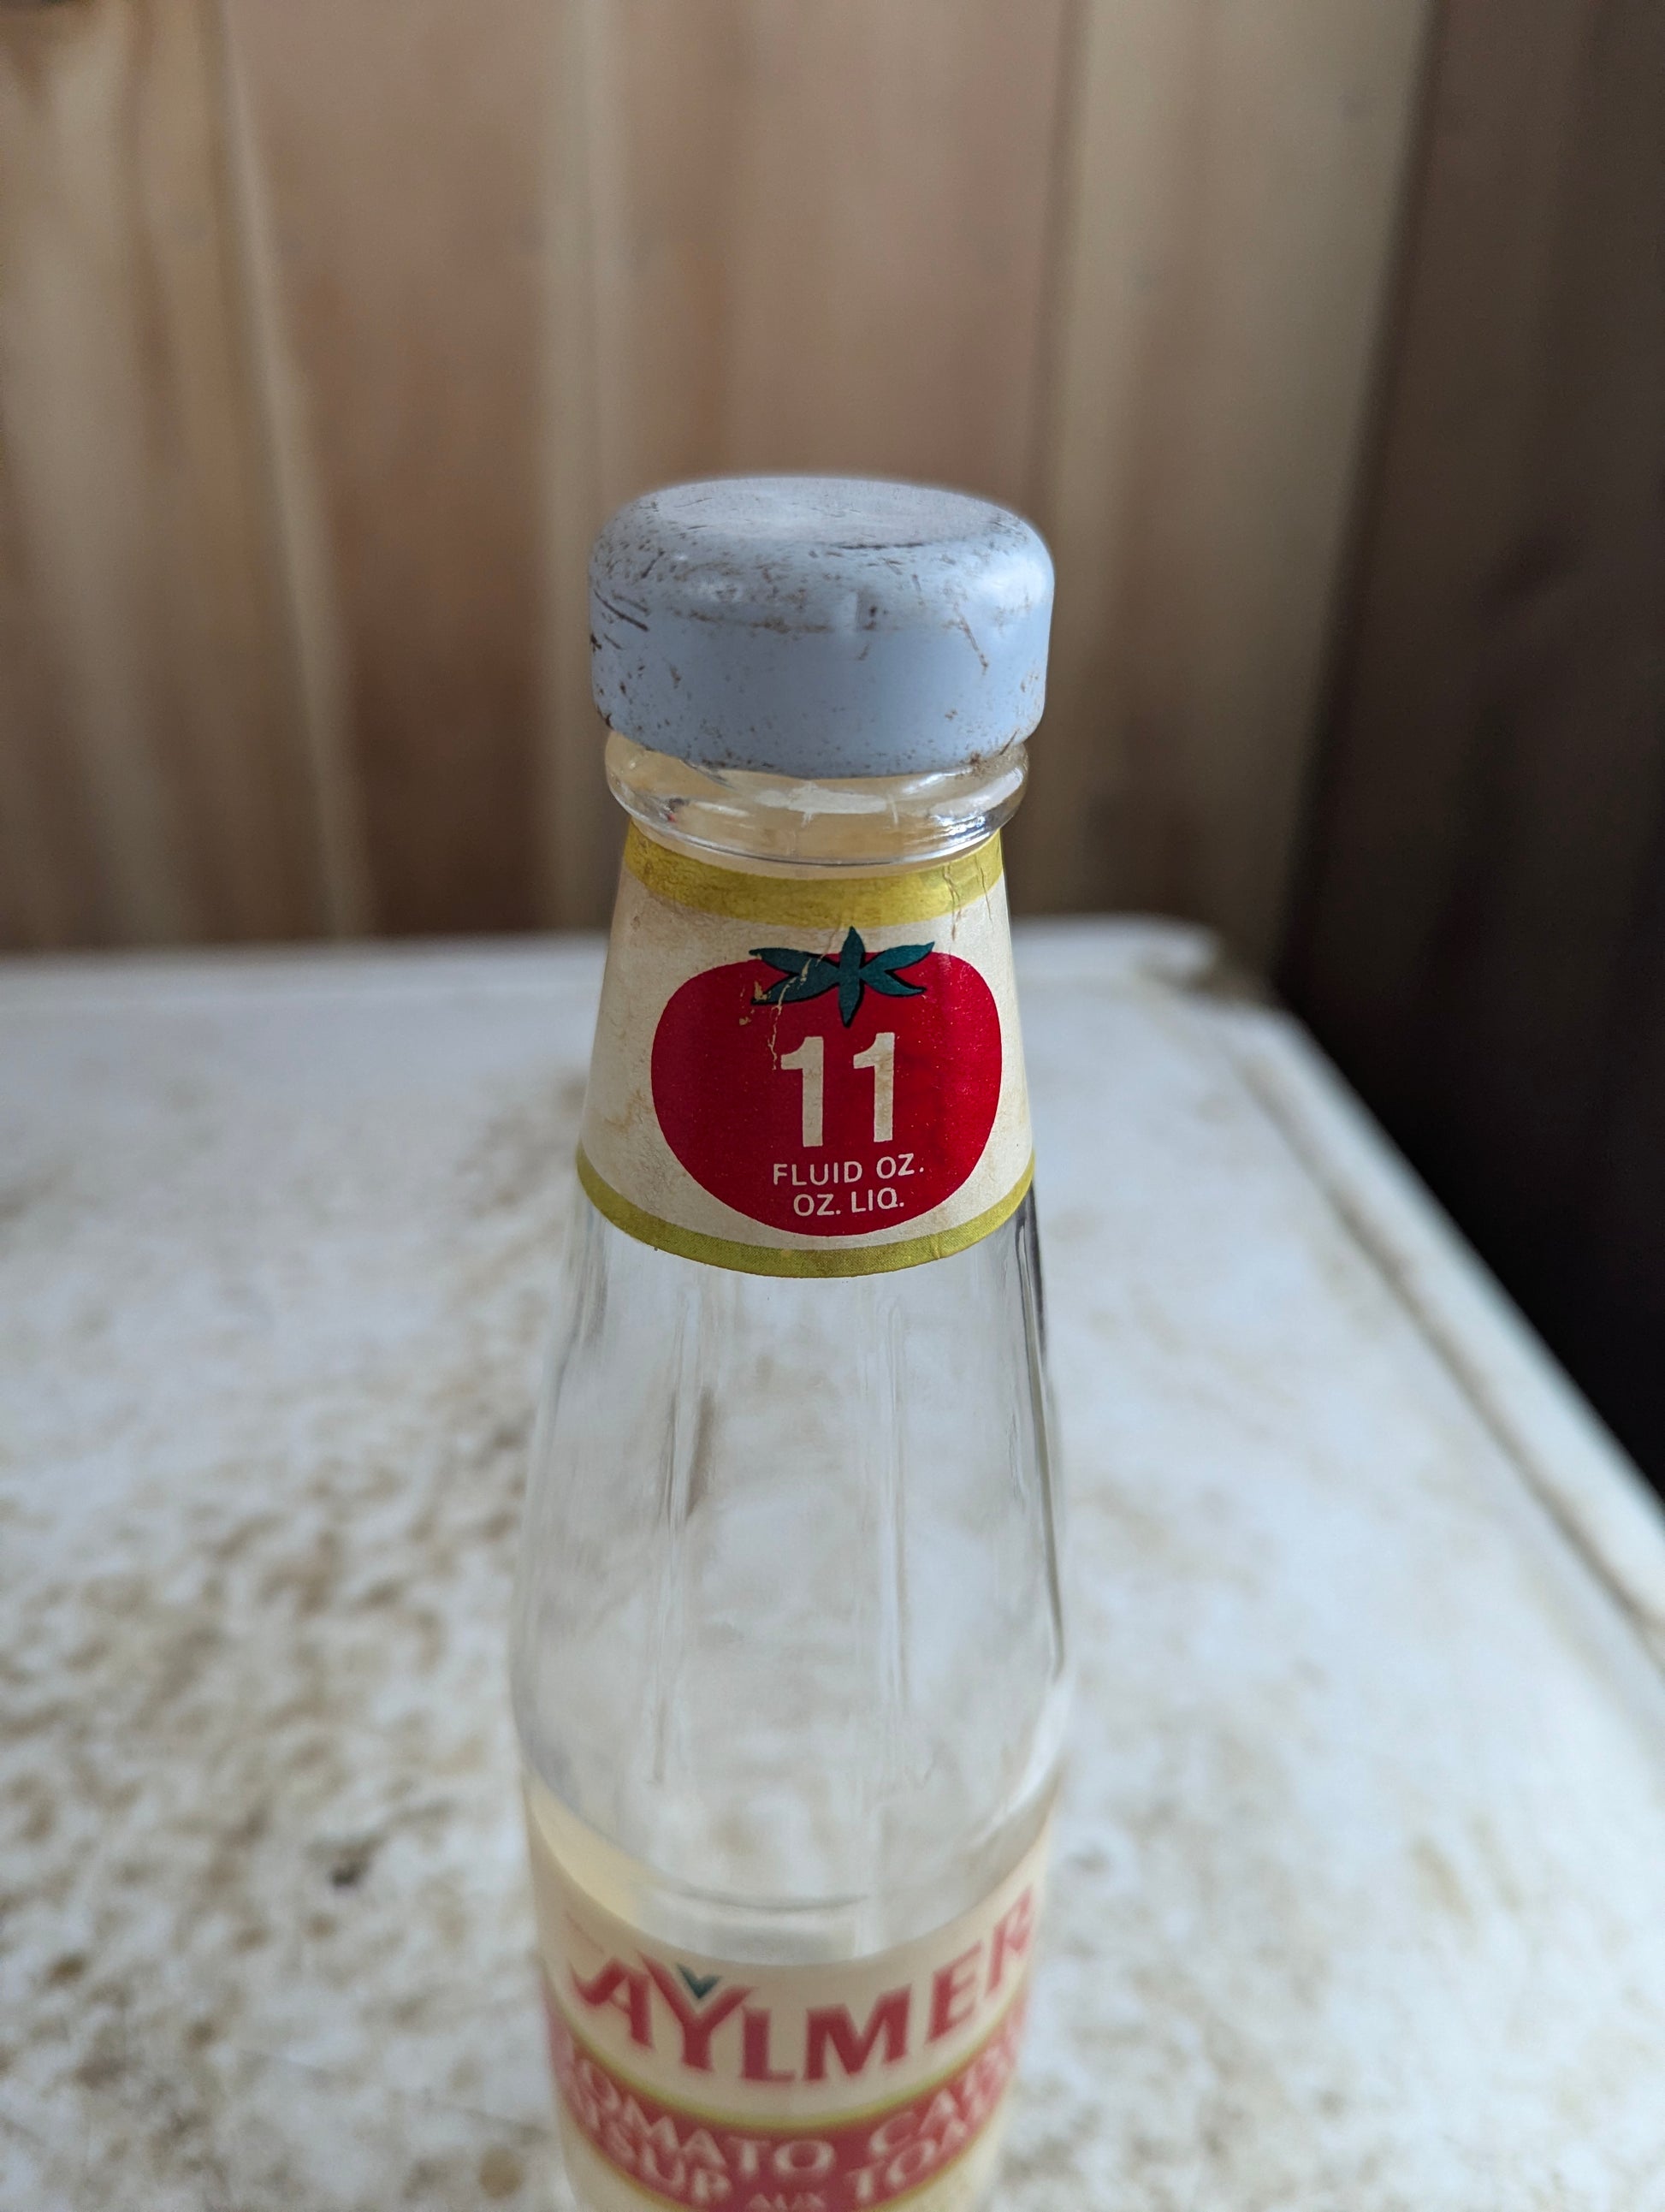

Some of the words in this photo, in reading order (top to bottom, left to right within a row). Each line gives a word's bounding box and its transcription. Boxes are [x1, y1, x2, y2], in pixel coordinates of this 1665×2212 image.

[780, 1032, 896, 1148] 11
[773, 1161, 863, 1187] FLUID
[876, 1153, 924, 1180] OZ.
[793, 1193, 841, 1217] OZ.
[851, 1187, 904, 1213] LIQ.
[569, 1887, 1032, 2083] AYLMER
[572, 2055, 838, 2179] OMATO
